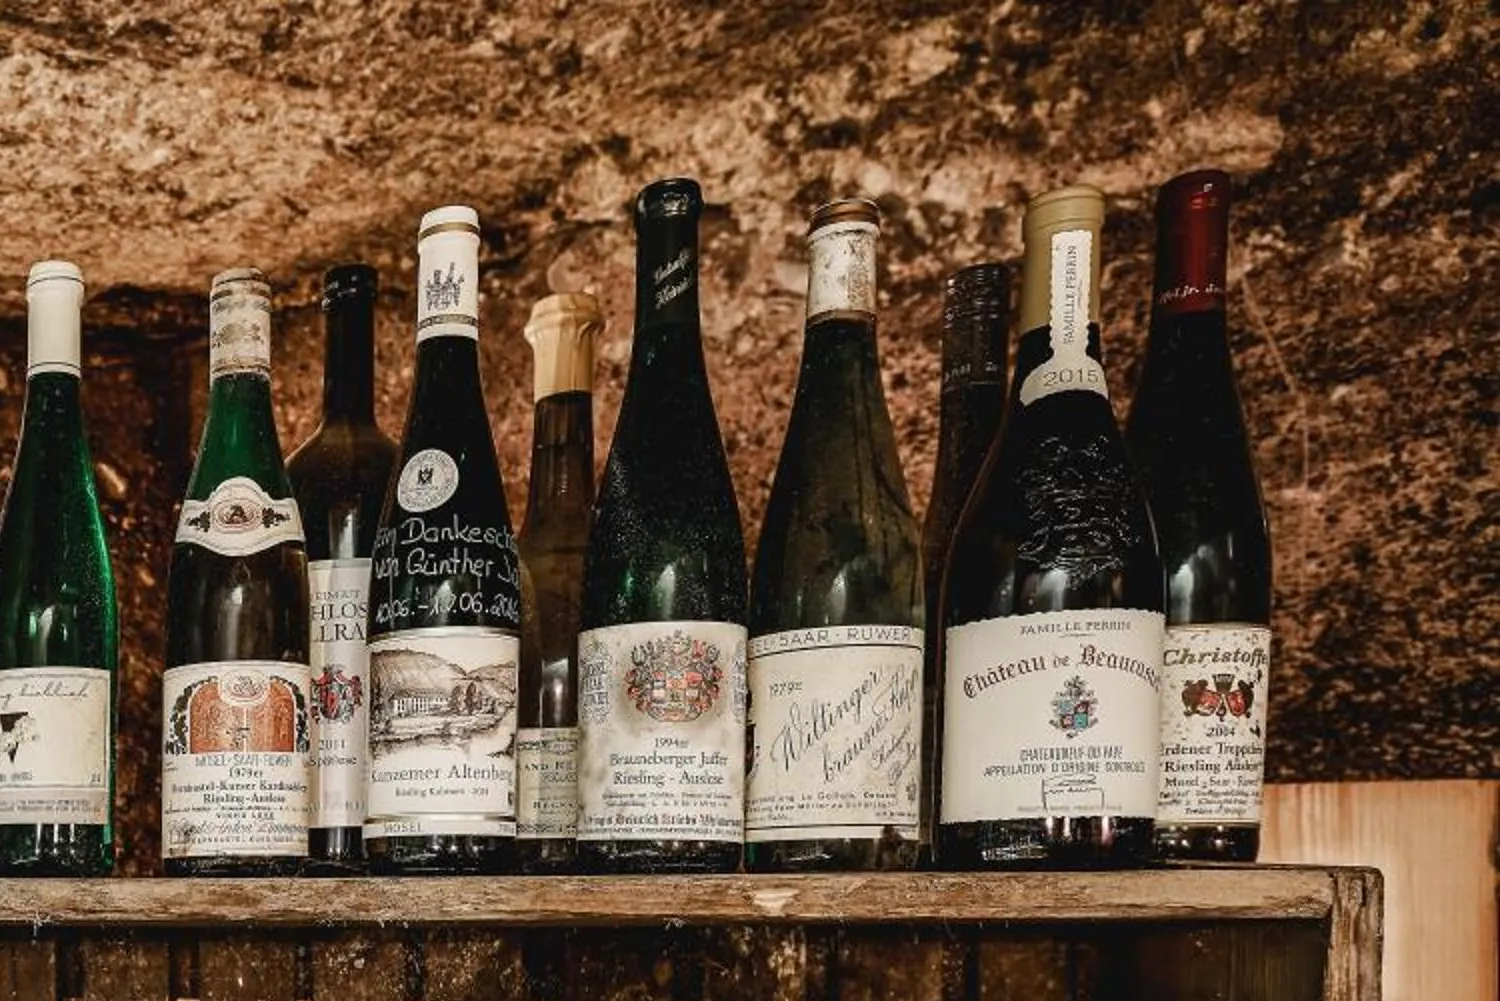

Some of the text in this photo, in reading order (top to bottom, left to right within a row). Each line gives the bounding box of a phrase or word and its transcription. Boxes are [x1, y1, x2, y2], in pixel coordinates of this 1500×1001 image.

[1043, 368, 1099, 386] 2015
[406, 547, 495, 578] Günther
[779, 629, 830, 648] SAAR
[848, 626, 912, 641] RUWER
[963, 655, 1046, 699] Château
[1053, 654, 1071, 669] de
[613, 771, 665, 787] Riesling
